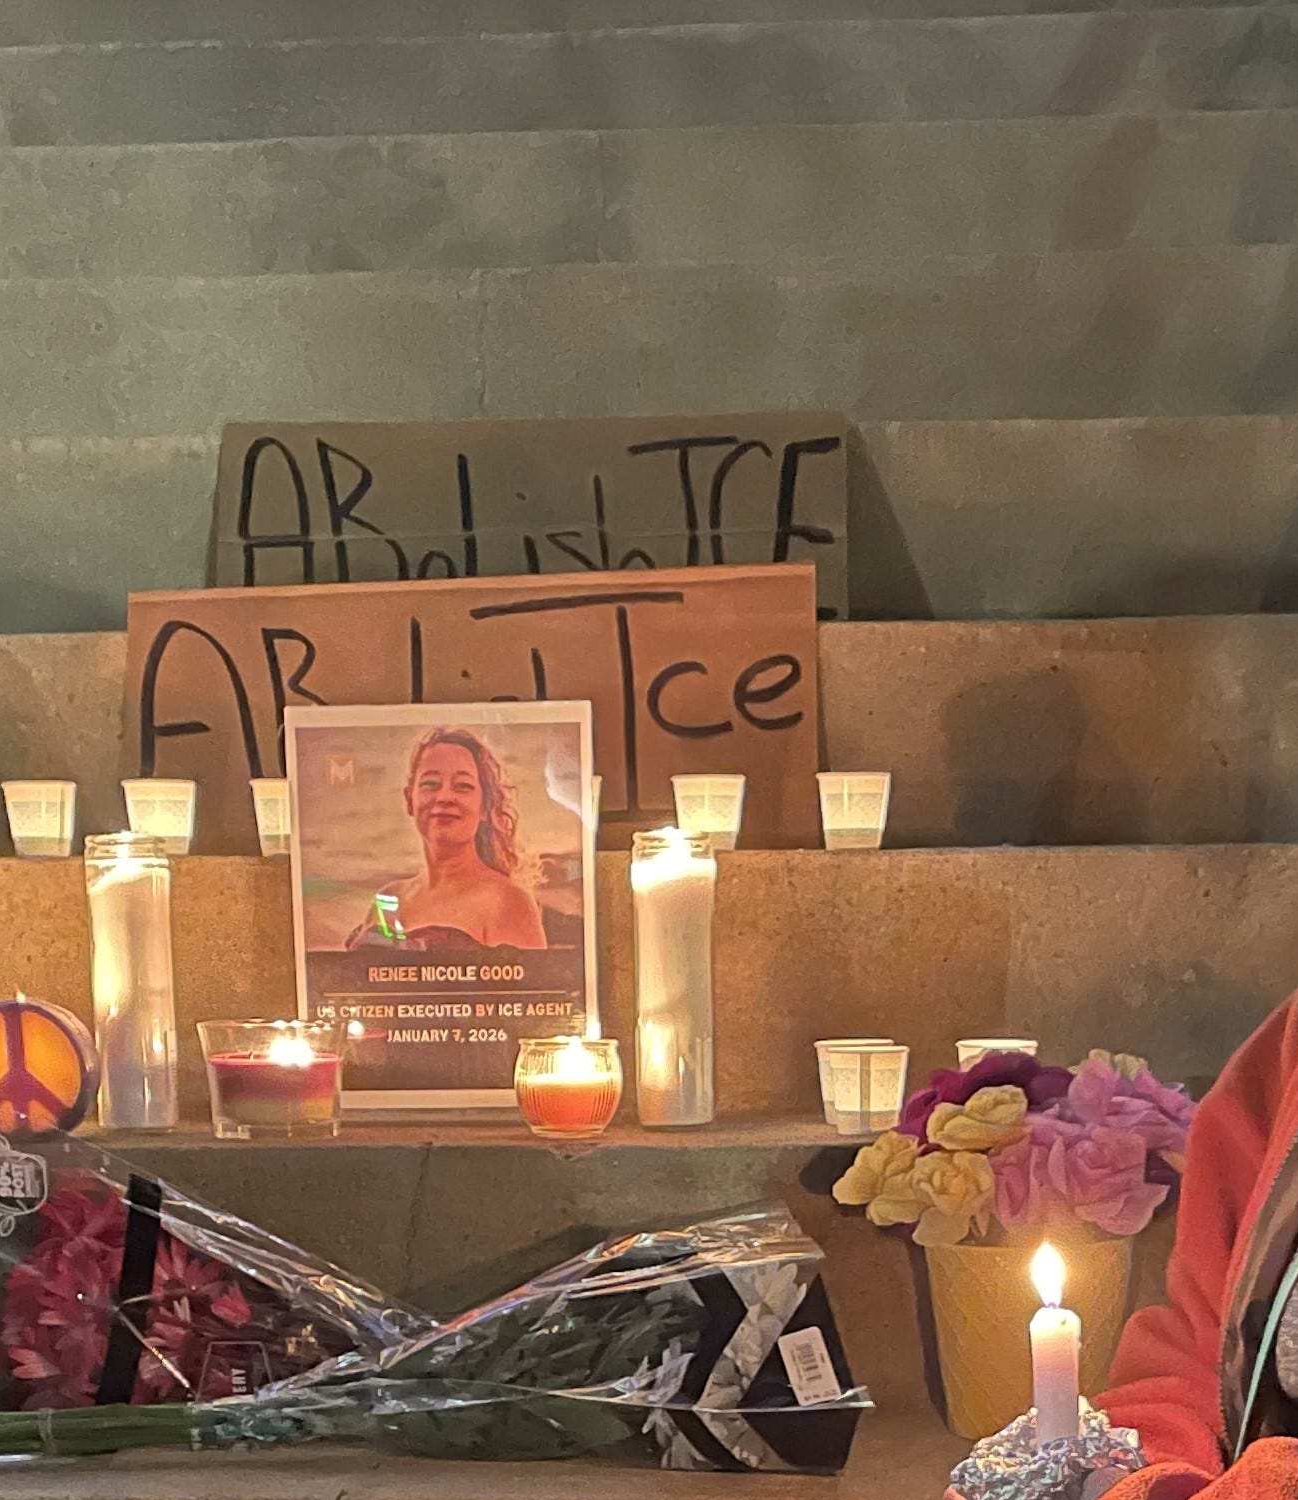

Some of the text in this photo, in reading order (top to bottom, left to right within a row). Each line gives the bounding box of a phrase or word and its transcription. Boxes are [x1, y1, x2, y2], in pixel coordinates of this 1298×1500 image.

[368, 964, 524, 982] RENEE NICOLE GOOD
[316, 1005, 336, 1018] US
[397, 1004, 472, 1018] EXECUTED
[475, 1004, 495, 1017] BY
[498, 1003, 523, 1016] ICE
[526, 1003, 573, 1016] AGENT
[387, 1028, 508, 1043] JANUARY 7, 2026
